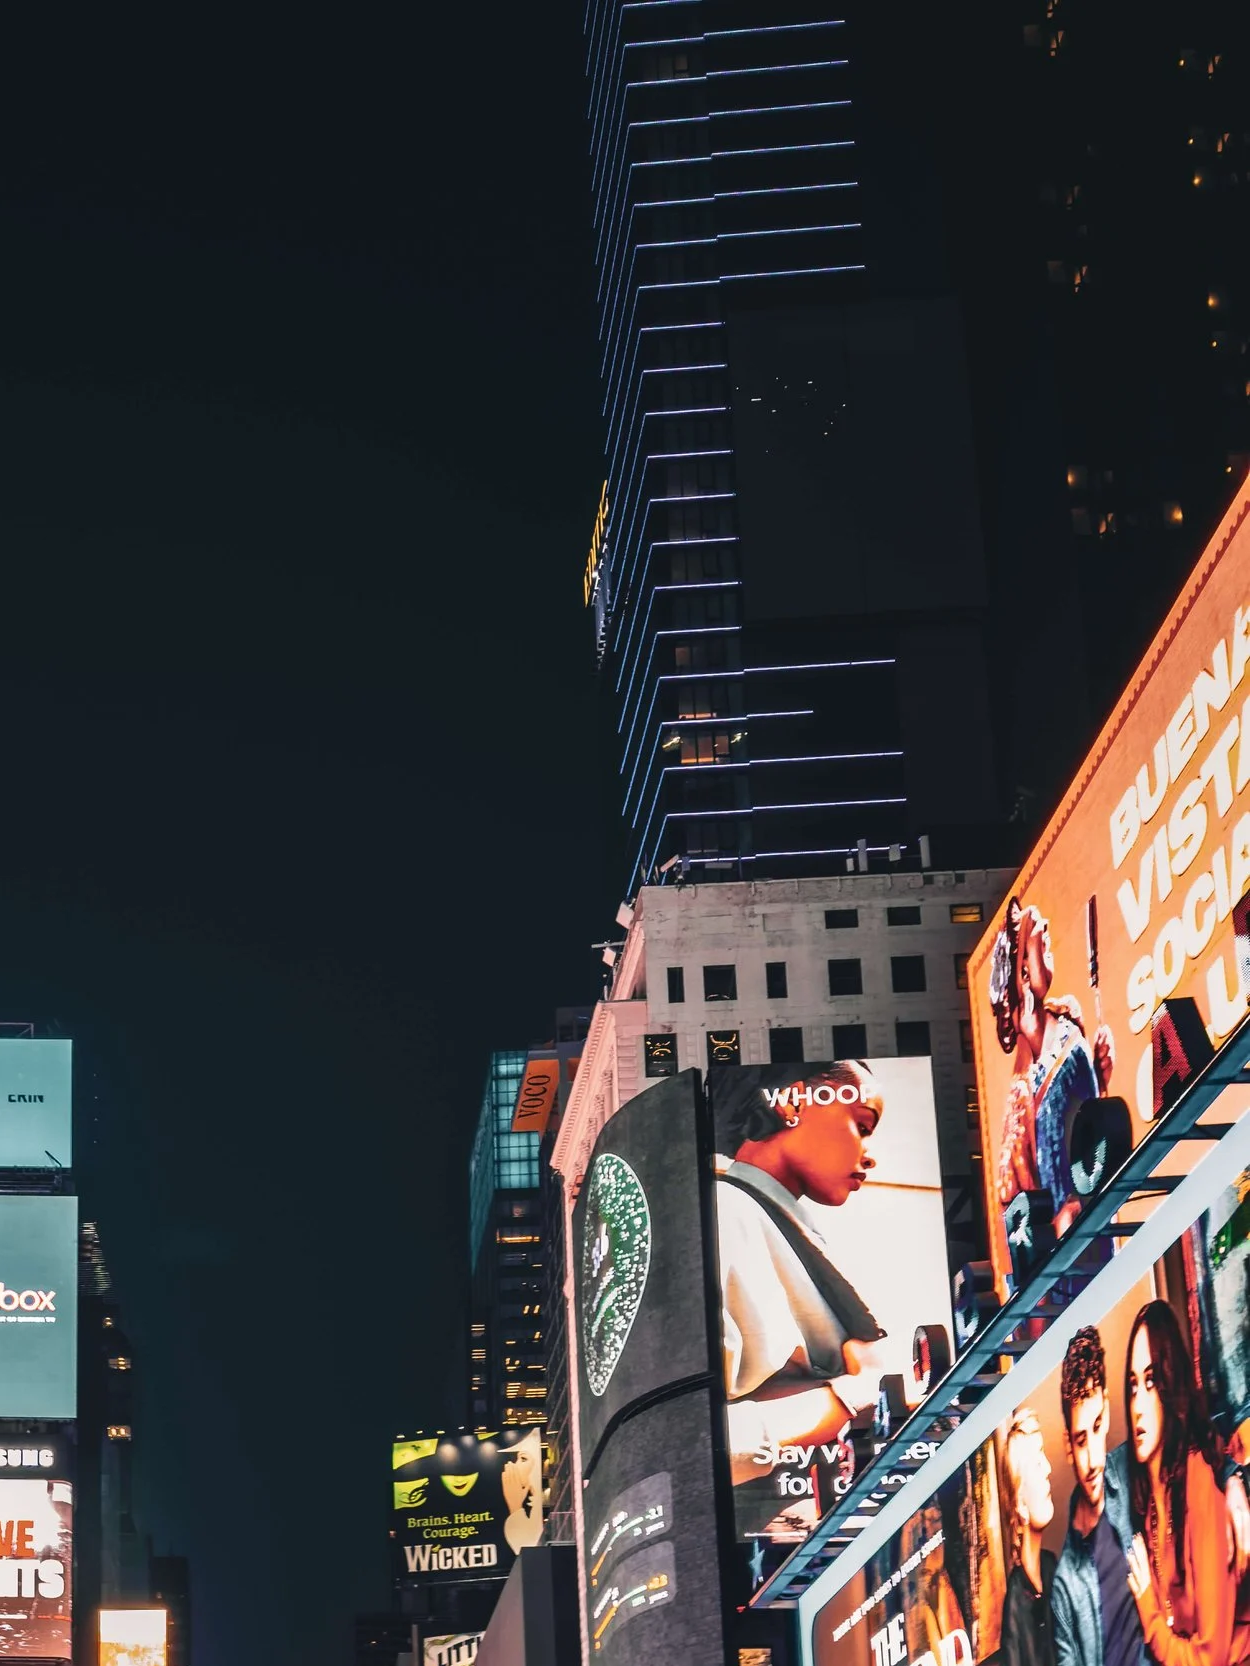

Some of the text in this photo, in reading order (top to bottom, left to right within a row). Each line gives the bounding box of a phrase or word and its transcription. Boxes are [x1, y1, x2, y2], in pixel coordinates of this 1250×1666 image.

[764, 1084, 883, 1109] WHOOP
[753, 1441, 815, 1469] Stay
[407, 1511, 495, 1528] Brains. Heart.
[422, 1525, 479, 1539] Courage.
